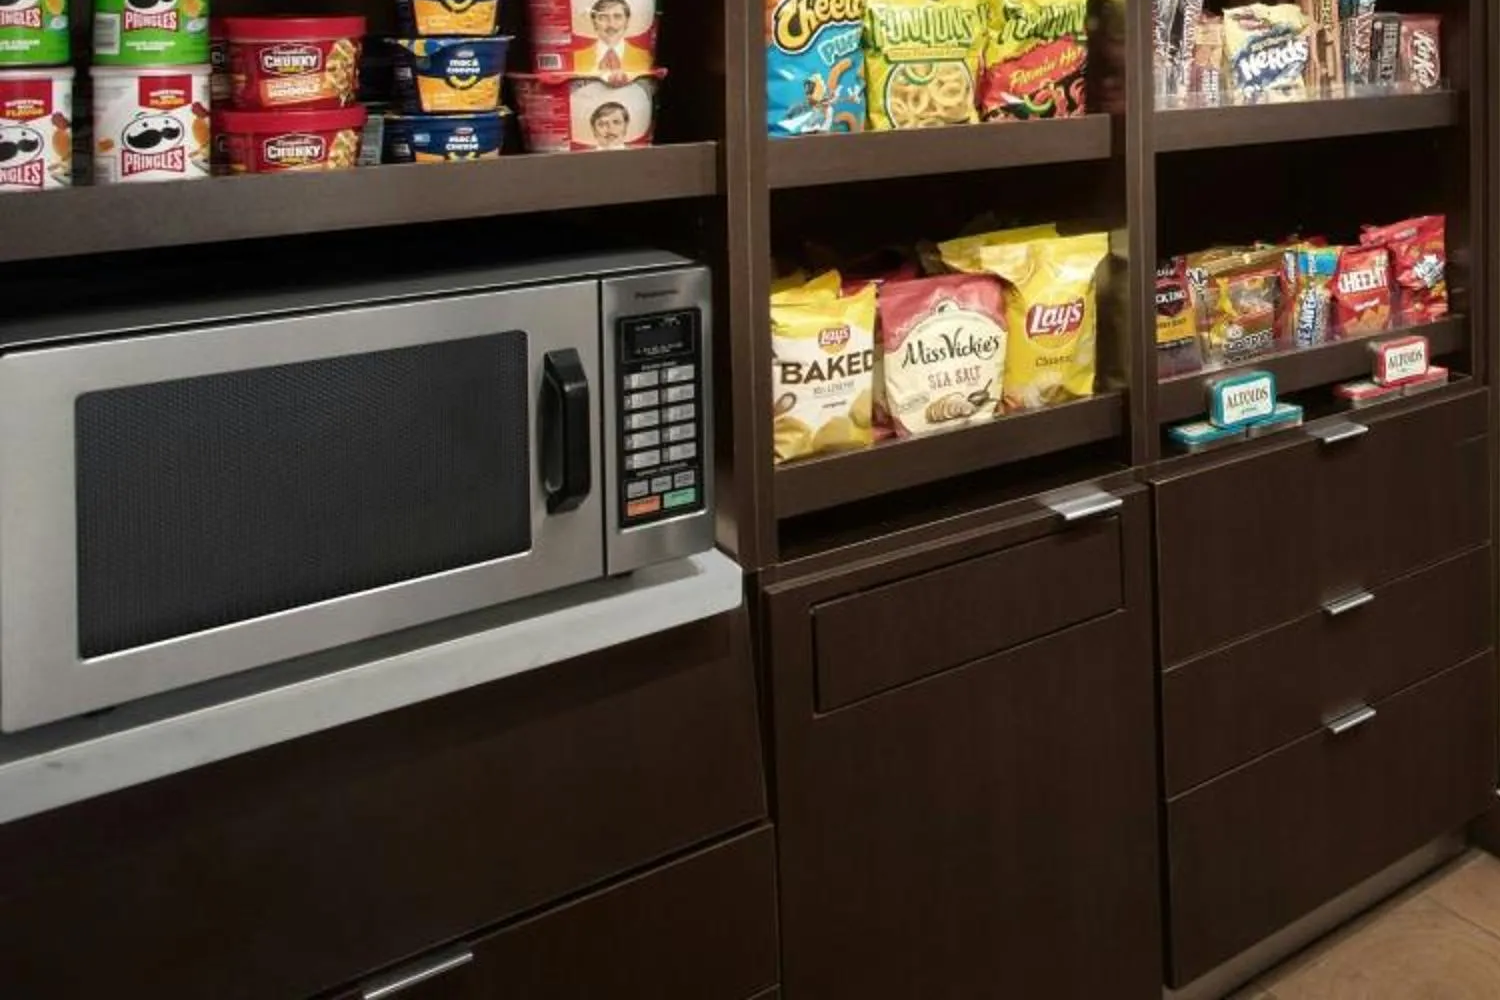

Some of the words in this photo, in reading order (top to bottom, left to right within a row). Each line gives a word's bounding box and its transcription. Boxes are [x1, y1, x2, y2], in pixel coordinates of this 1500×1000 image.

[124, 11, 177, 31] PRINGLES
[263, 53, 318, 69] CHUNKY
[266, 144, 321, 159] CHUNKY
[124, 152, 184, 174] PRINGLES
[1029, 300, 1086, 334] Lay's
[781, 349, 874, 385] BAKED
[927, 371, 953, 389] SEA
[954, 364, 982, 386] SALT
